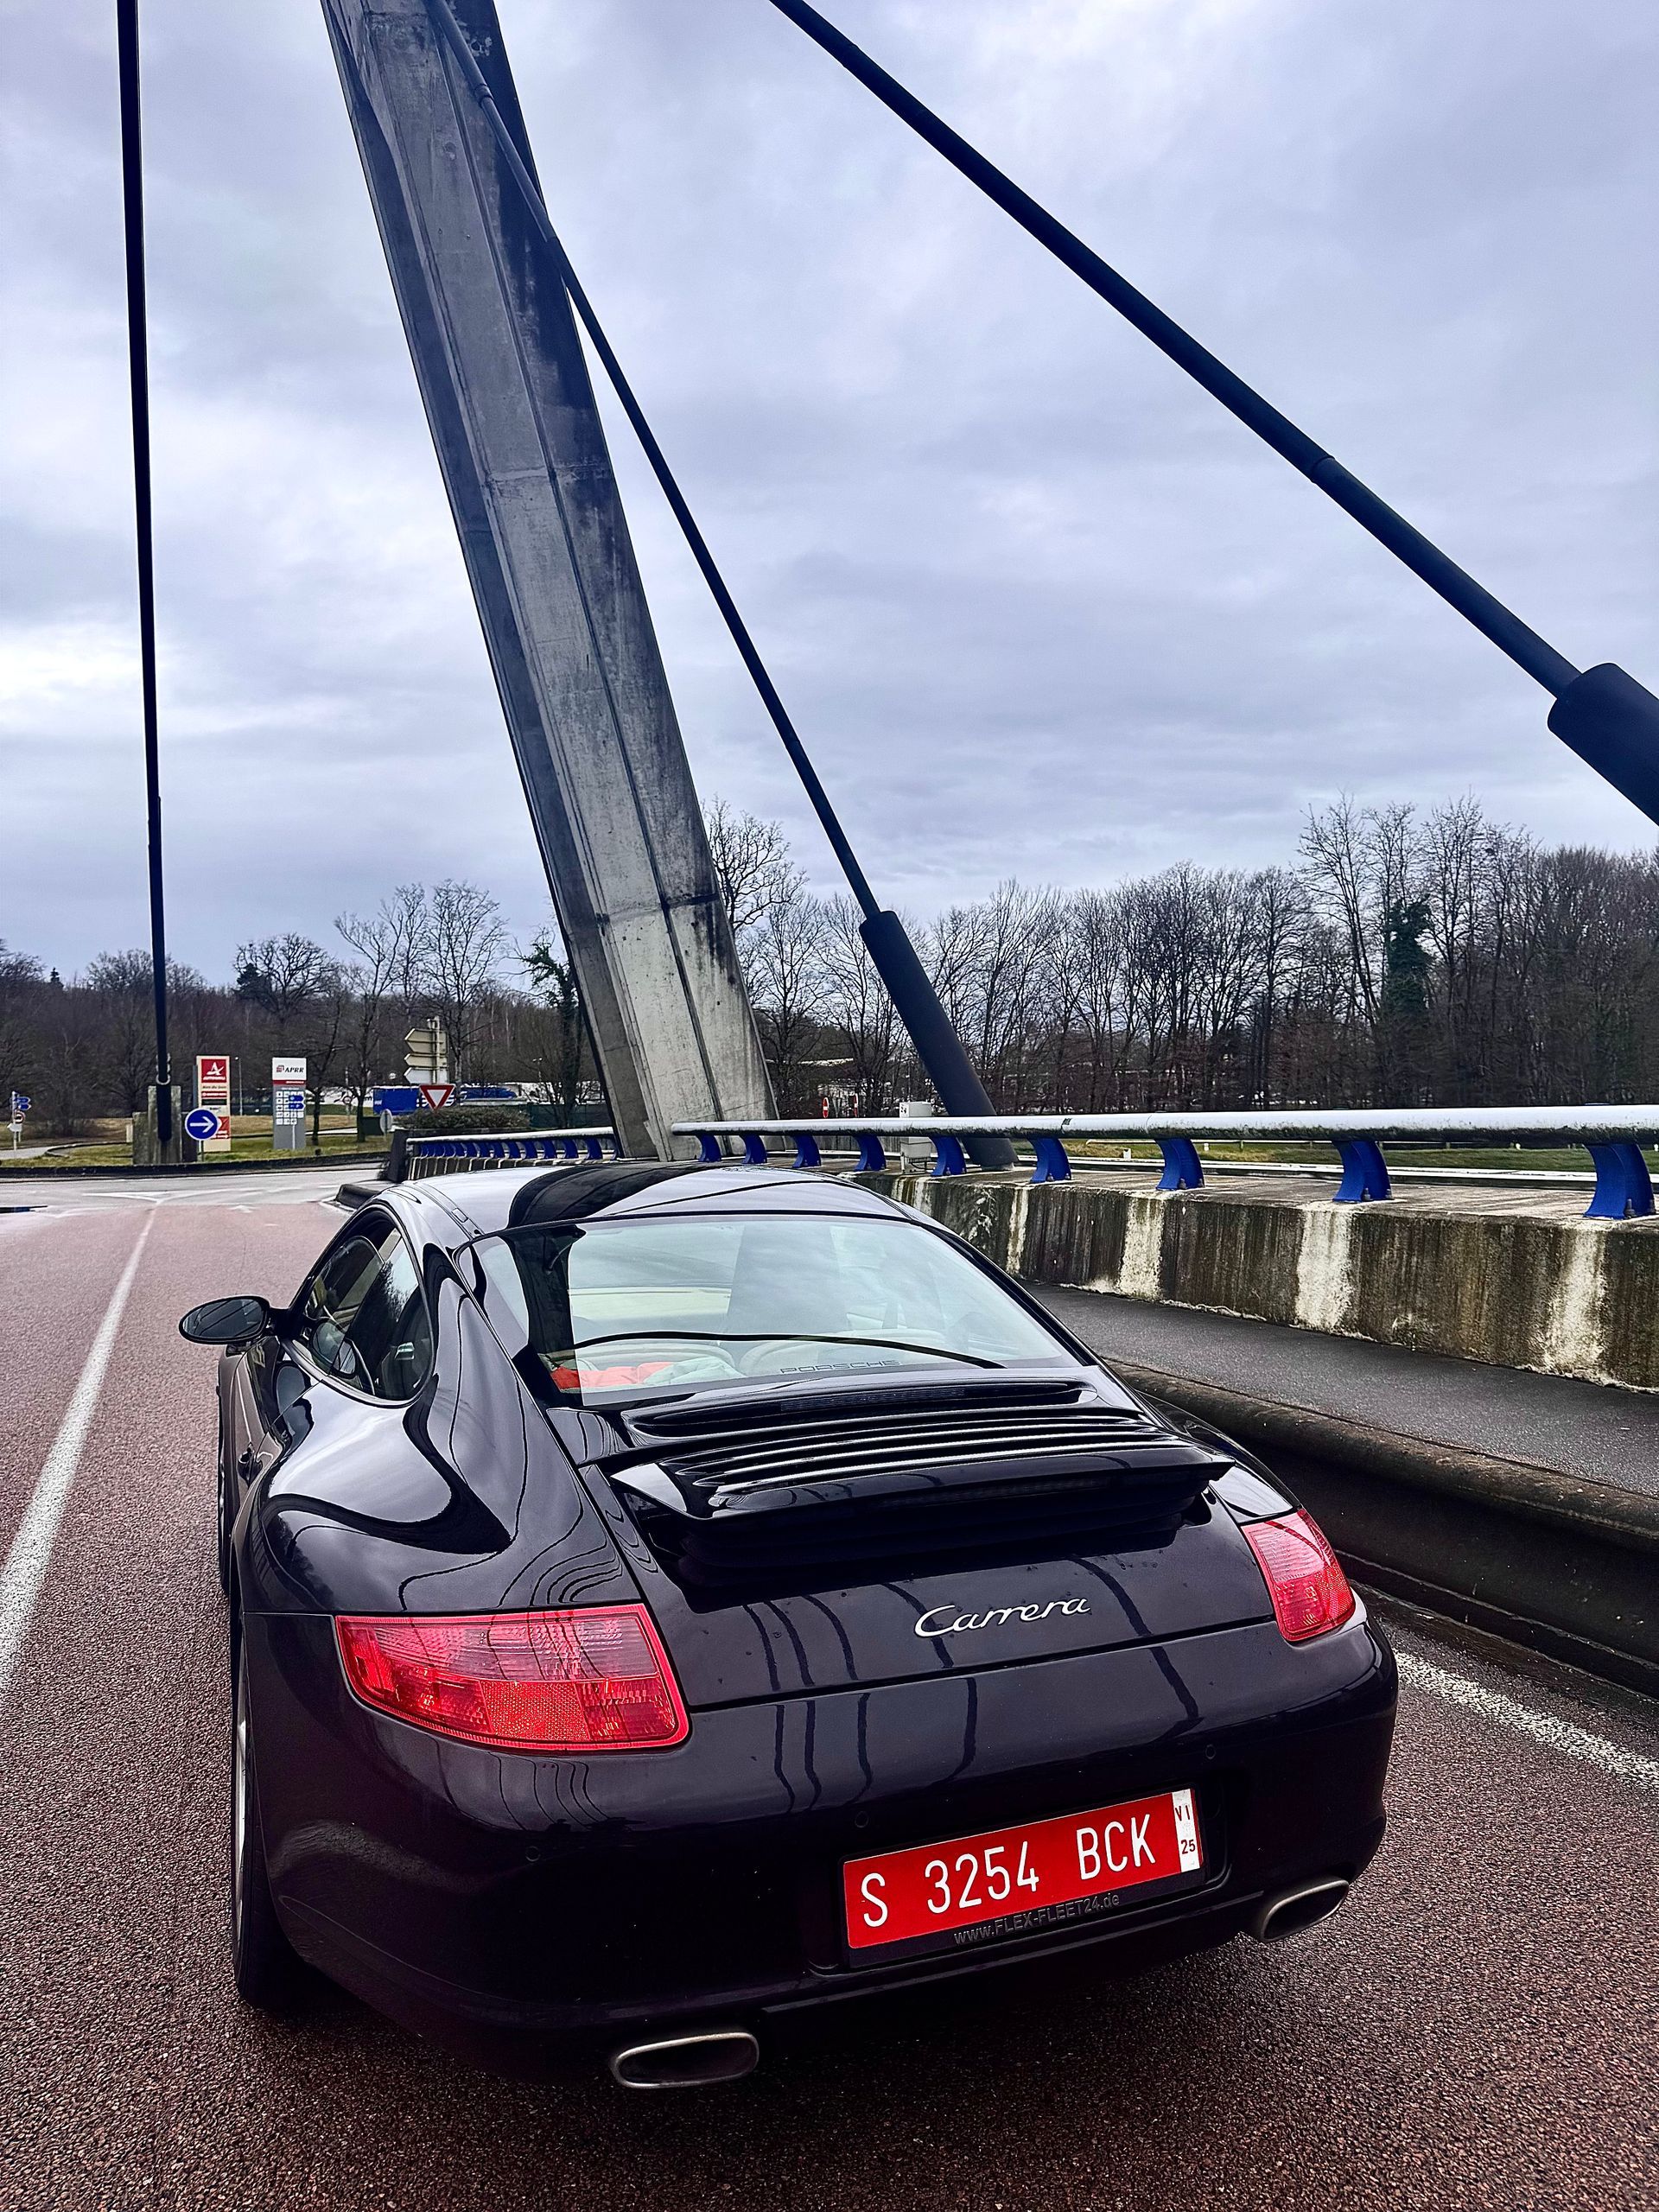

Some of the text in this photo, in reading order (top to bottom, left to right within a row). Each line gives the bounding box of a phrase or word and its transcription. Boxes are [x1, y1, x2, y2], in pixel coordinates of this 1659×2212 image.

[780, 1360, 900, 1374] PORSCHE
[914, 1598, 1090, 1637] Carrera
[1175, 1804, 1192, 1822] VI
[1181, 1839, 1197, 1855] 25
[861, 1814, 1156, 1927] S 3254 BCK
[954, 1892, 1121, 1945] www.FLEX-FLEET24.de
